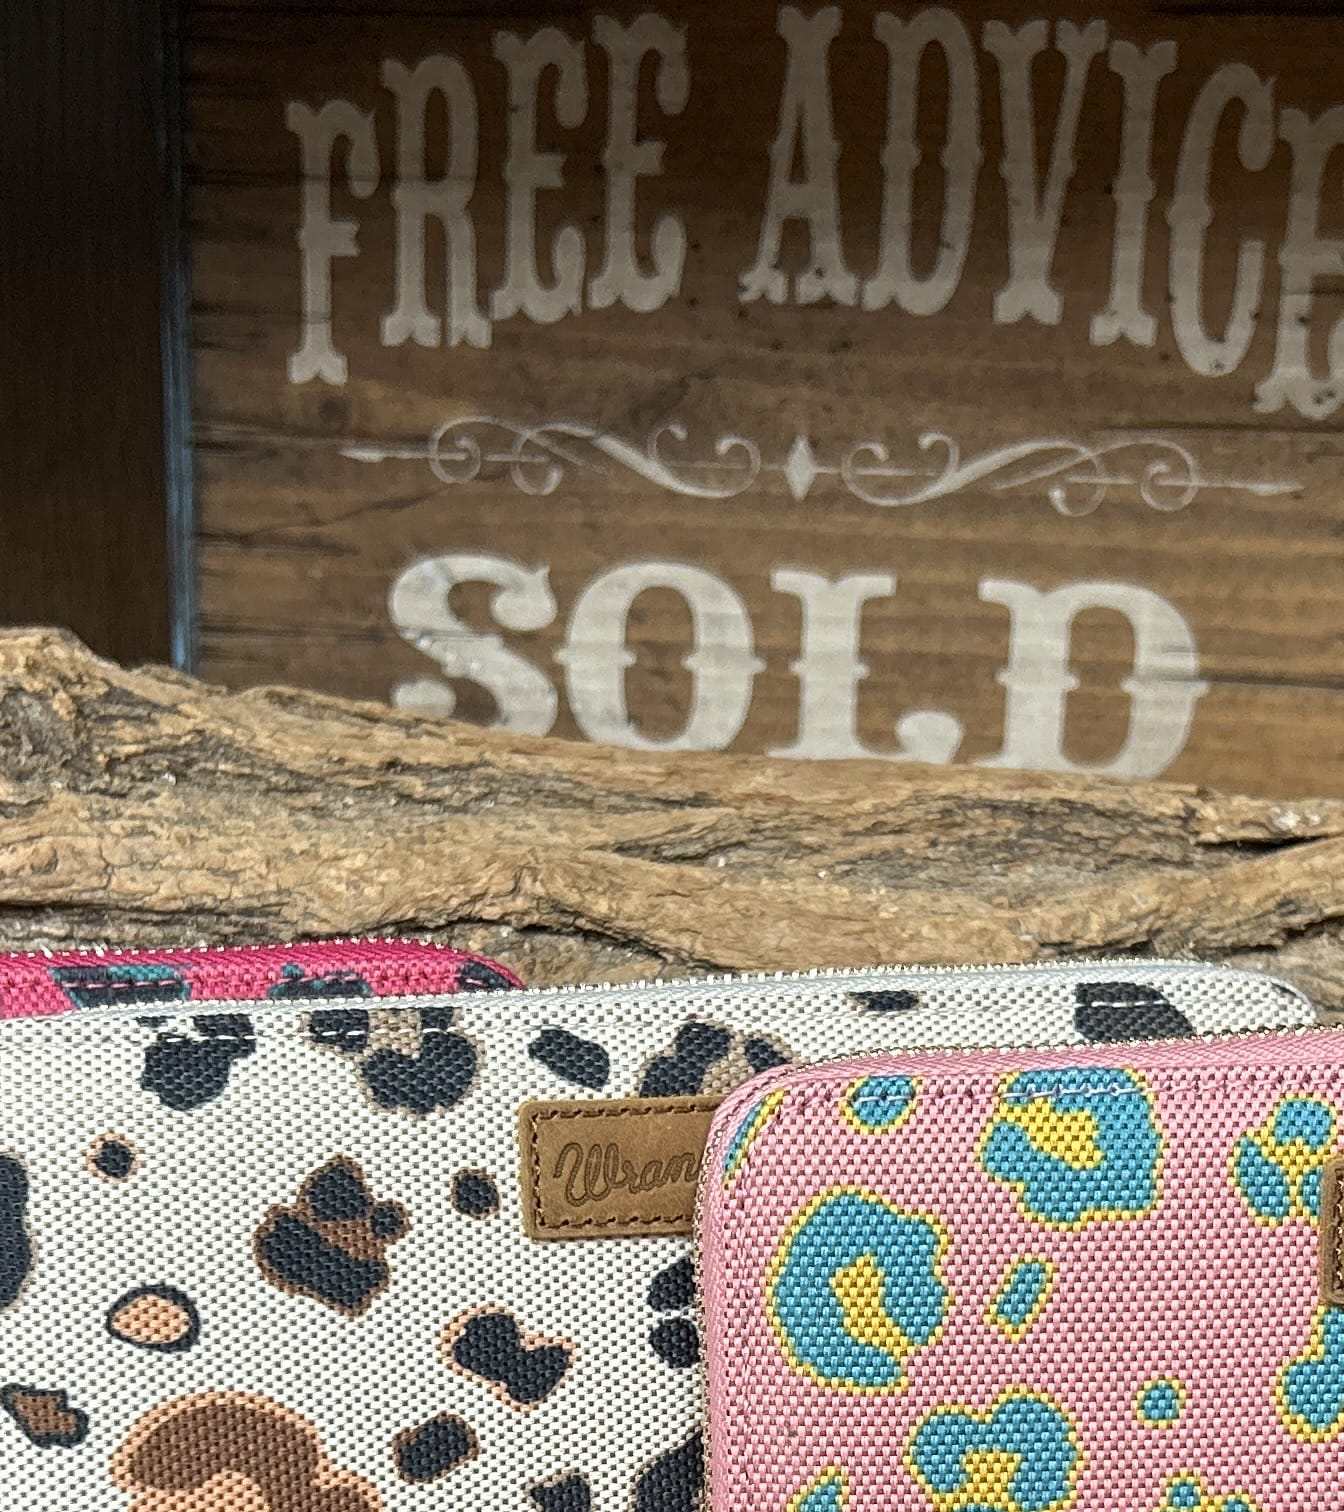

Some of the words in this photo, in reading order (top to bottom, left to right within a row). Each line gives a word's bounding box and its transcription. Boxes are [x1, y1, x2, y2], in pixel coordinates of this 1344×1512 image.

[285, 12, 691, 386] FREE
[390, 553, 1210, 780] SOLD
[552, 1142, 703, 1207] Wran
